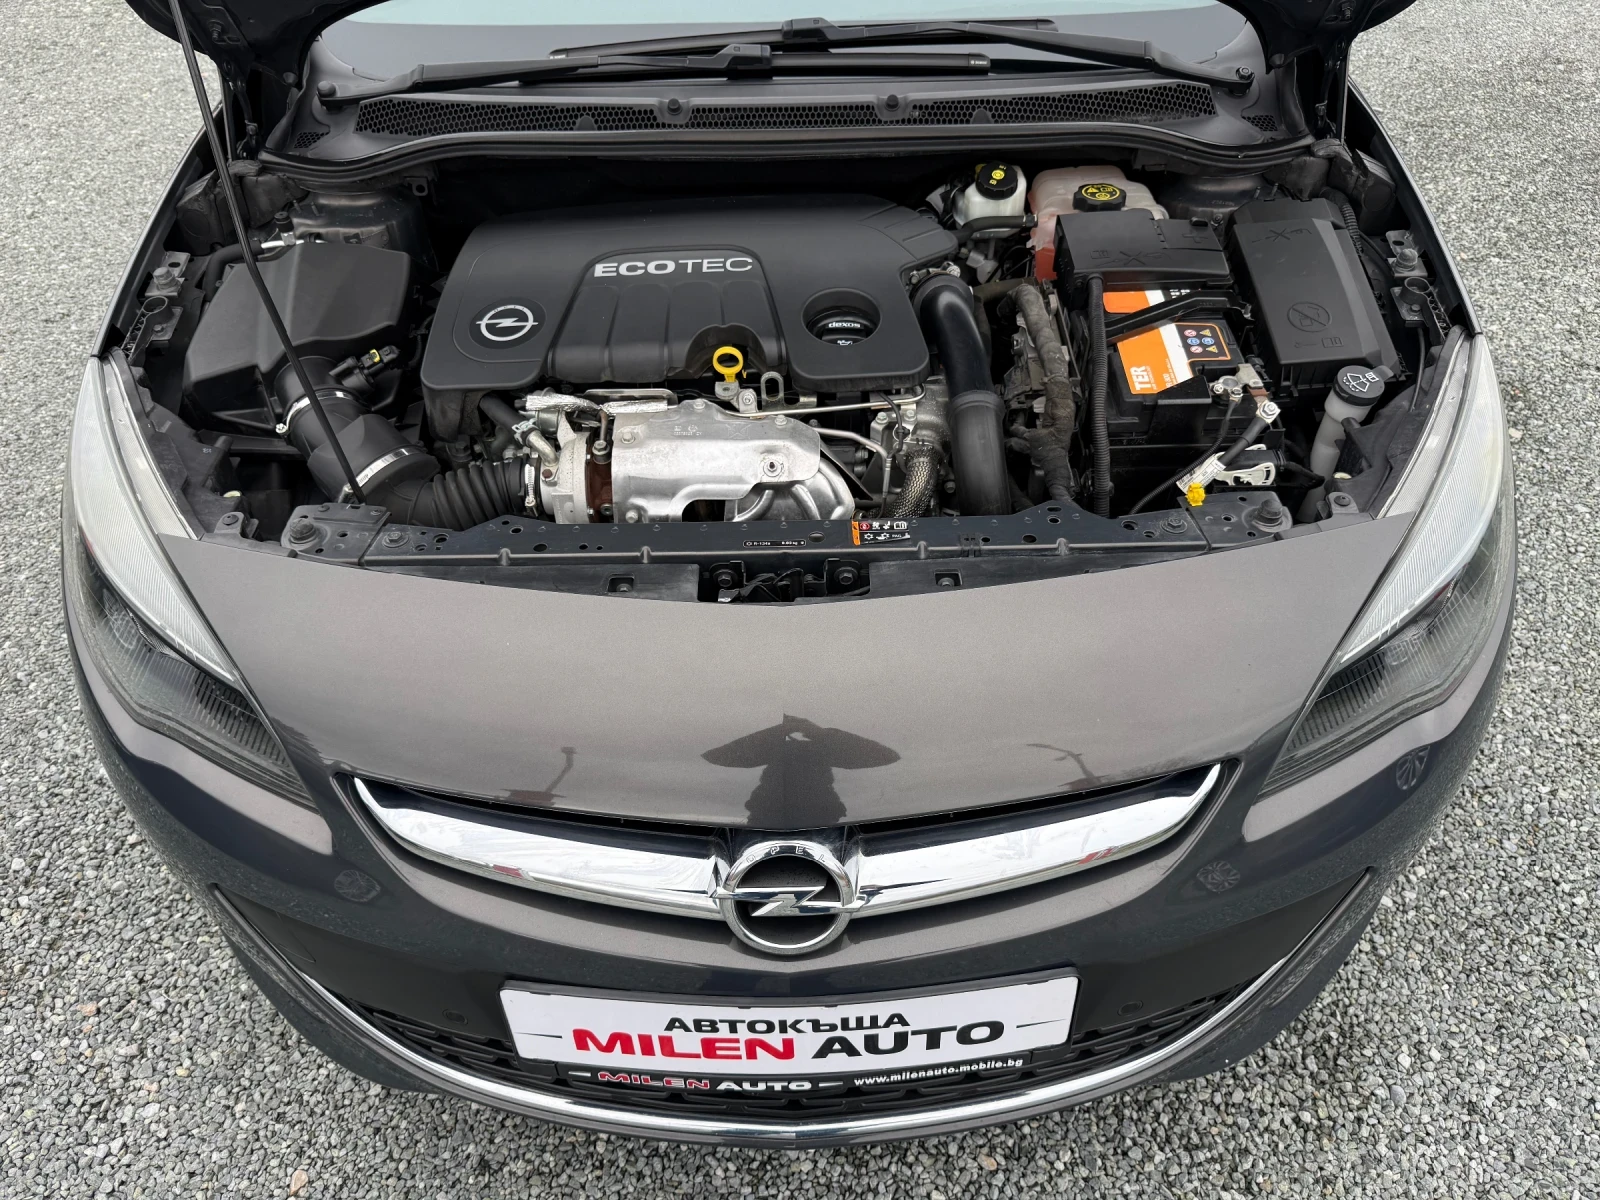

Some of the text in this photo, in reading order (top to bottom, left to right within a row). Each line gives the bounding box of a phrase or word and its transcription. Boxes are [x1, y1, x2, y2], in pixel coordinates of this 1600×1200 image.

[594, 257, 753, 277] ECOTEC
[664, 1013, 910, 1034] АВТОКЪША
[572, 1020, 1005, 1060] MILEN AUTO
[597, 1058, 1024, 1092] MILEN AUTO www.milenauto.mobile.bg
